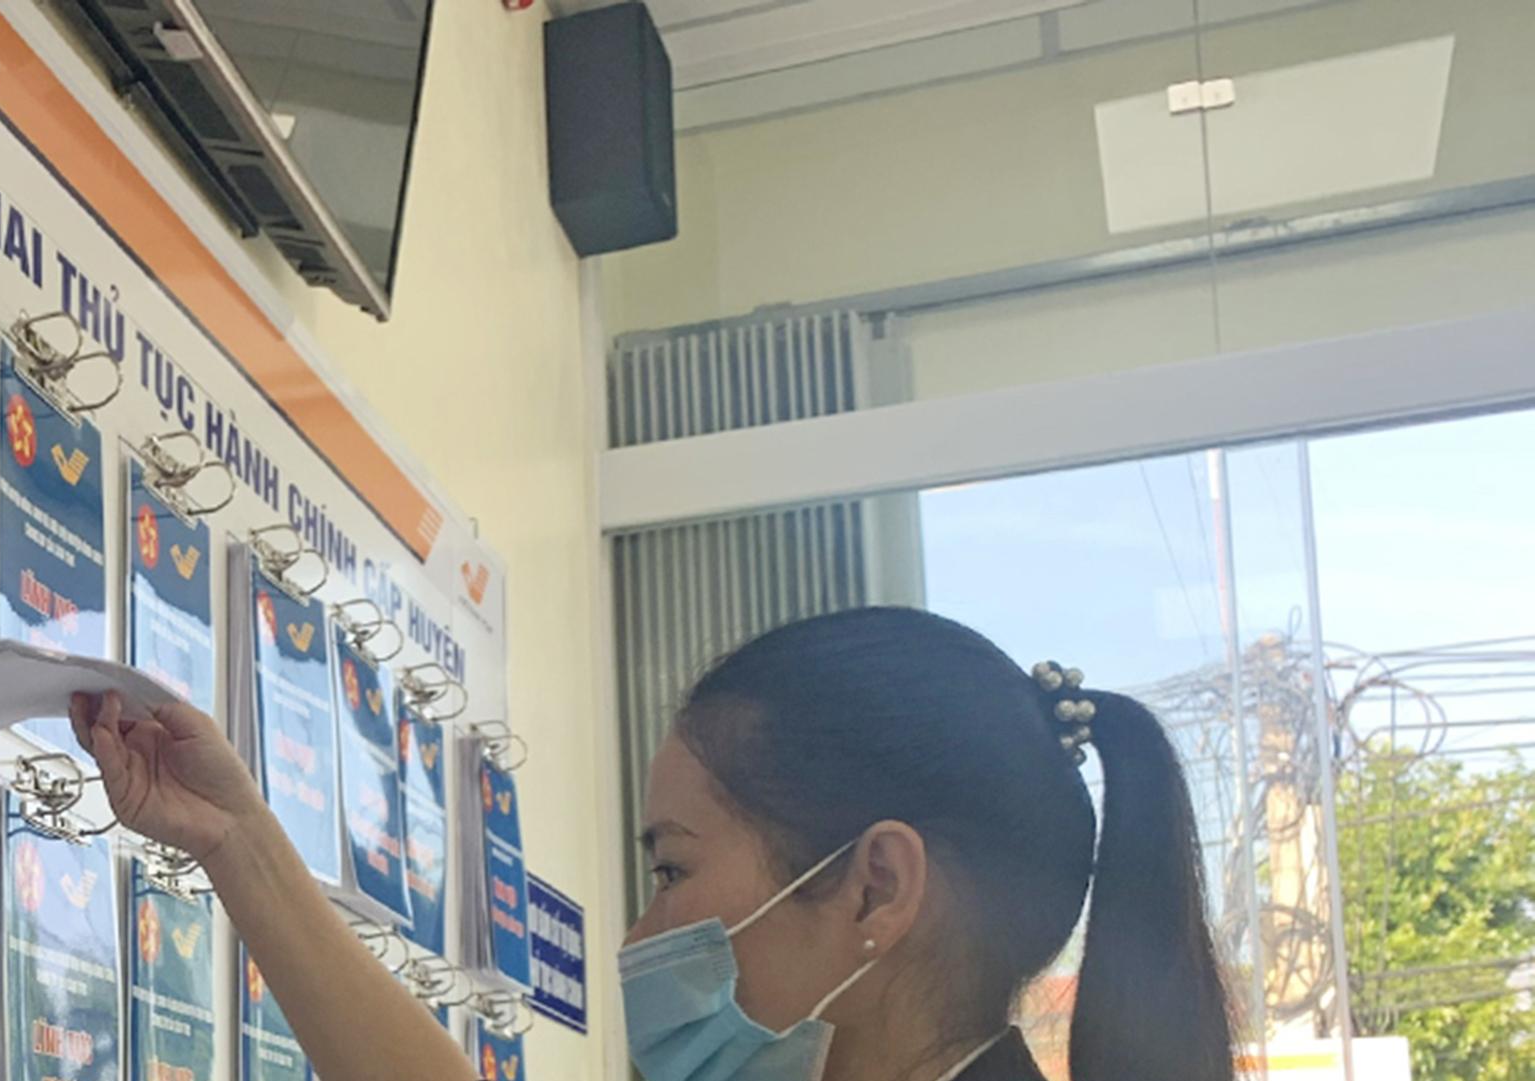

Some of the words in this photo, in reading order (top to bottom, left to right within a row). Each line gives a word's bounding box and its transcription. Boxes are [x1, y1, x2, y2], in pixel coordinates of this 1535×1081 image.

[56, 251, 126, 363] THỦ
[136, 331, 194, 432] TỤC
[205, 404, 279, 512] HÀNH
[287, 482, 357, 586] CHÍNH
